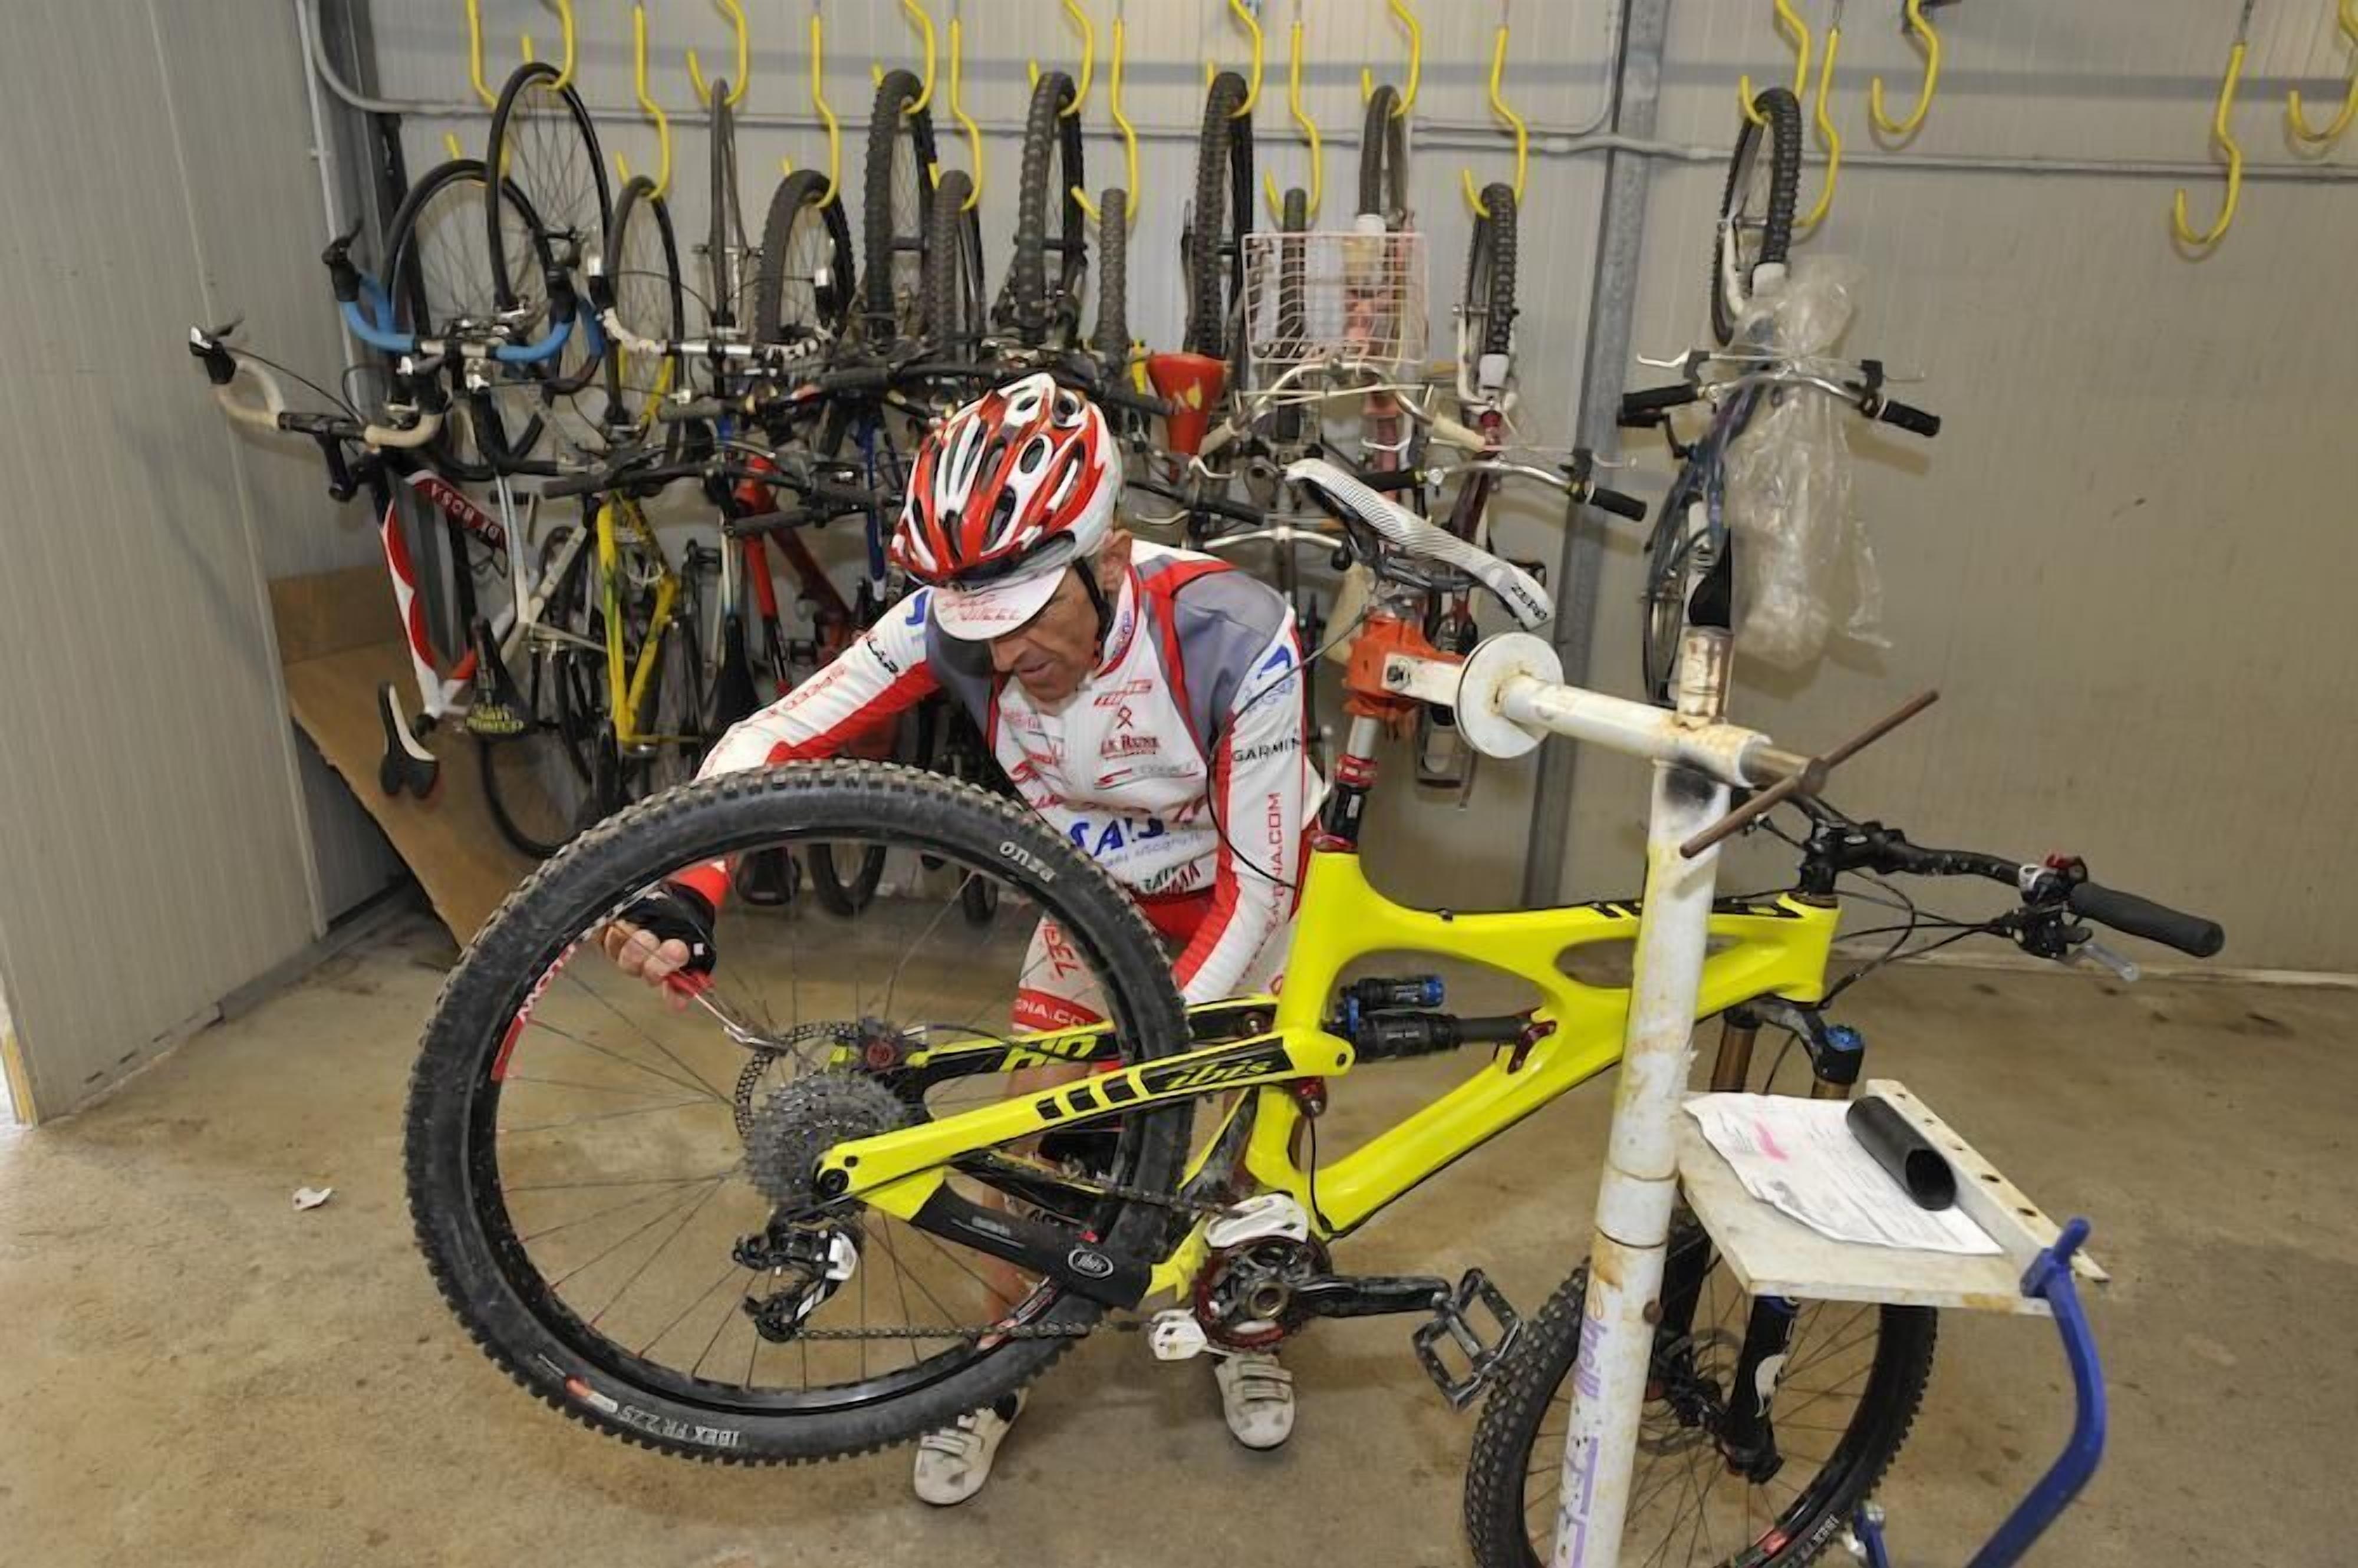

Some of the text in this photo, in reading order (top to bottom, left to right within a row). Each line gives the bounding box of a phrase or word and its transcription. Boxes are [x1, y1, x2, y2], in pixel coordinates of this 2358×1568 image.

[1511, 582, 1547, 621] ZERO
[1232, 737, 1300, 762] GARMIN
[1000, 841, 1056, 882] onza
[1165, 1059, 1272, 1091] ibis
[692, 1425, 740, 1447] IBEX
